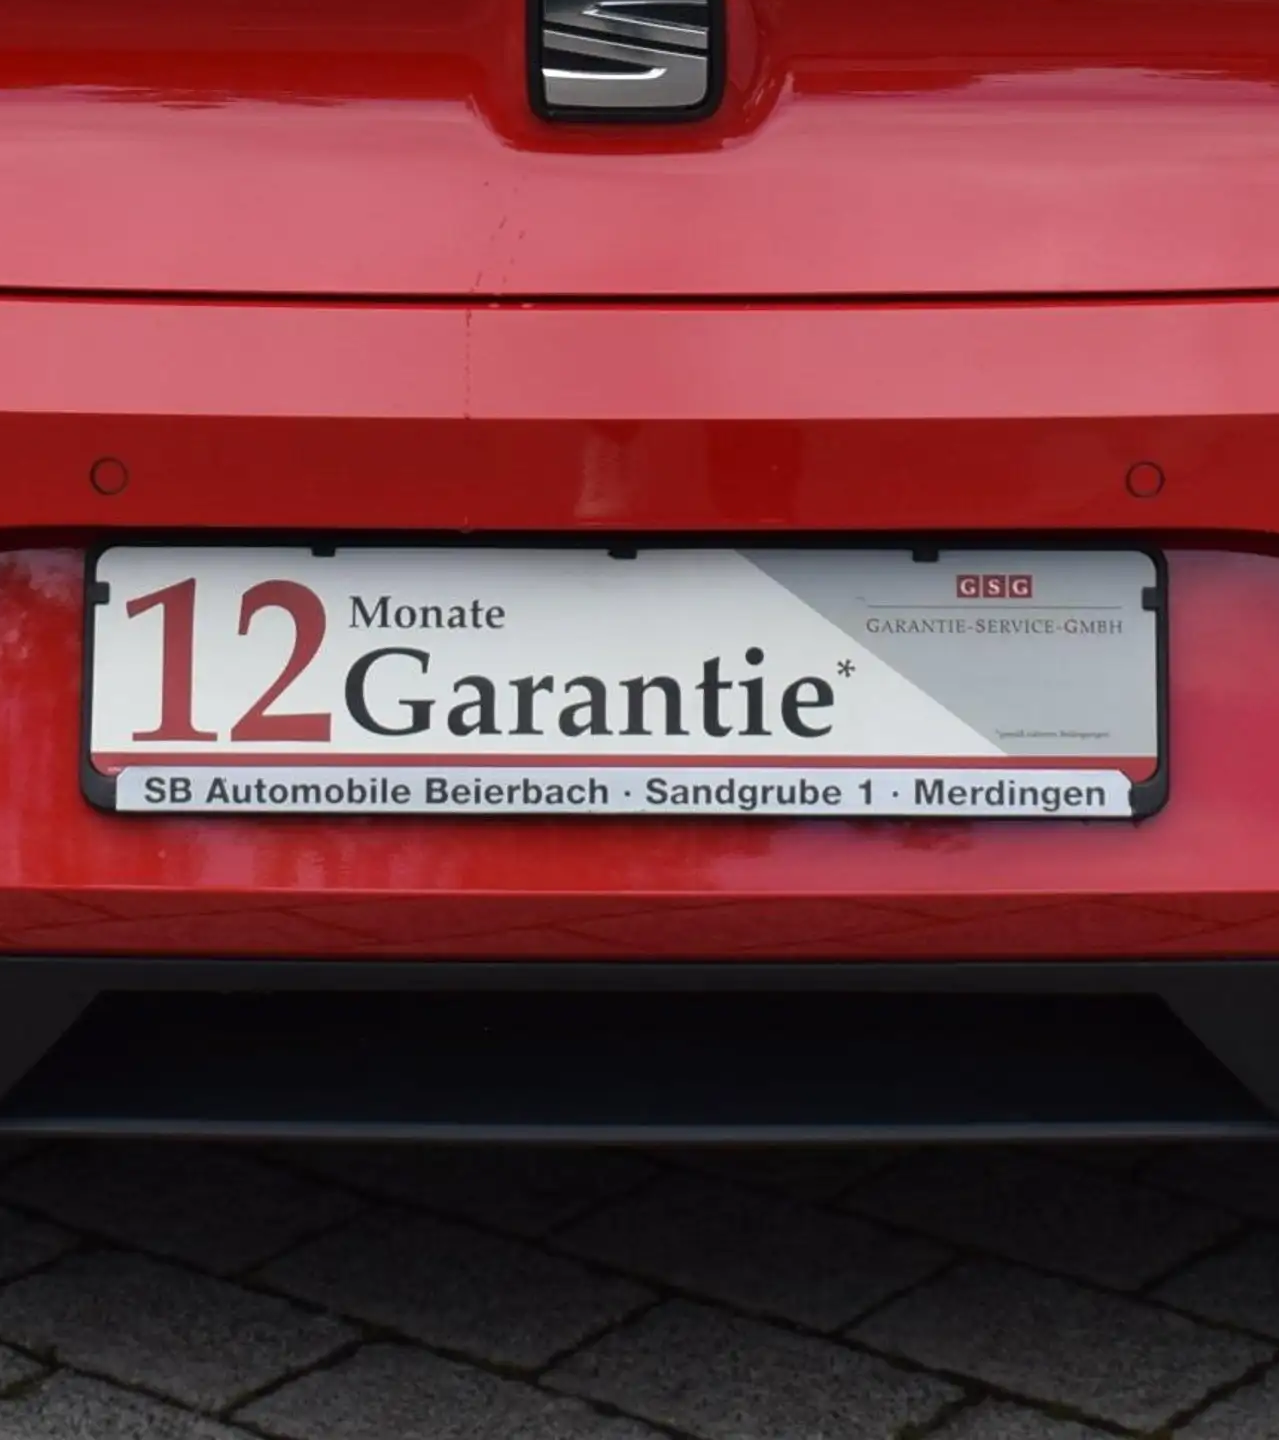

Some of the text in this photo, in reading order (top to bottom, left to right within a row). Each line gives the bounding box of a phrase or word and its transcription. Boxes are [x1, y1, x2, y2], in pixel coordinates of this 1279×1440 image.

[958, 576, 1031, 597] GSG
[348, 596, 506, 629] Monate
[125, 577, 332, 743] 12
[144, 777, 1107, 812] SB Automobile Beierbach Sandgrube 1 Merdingen
